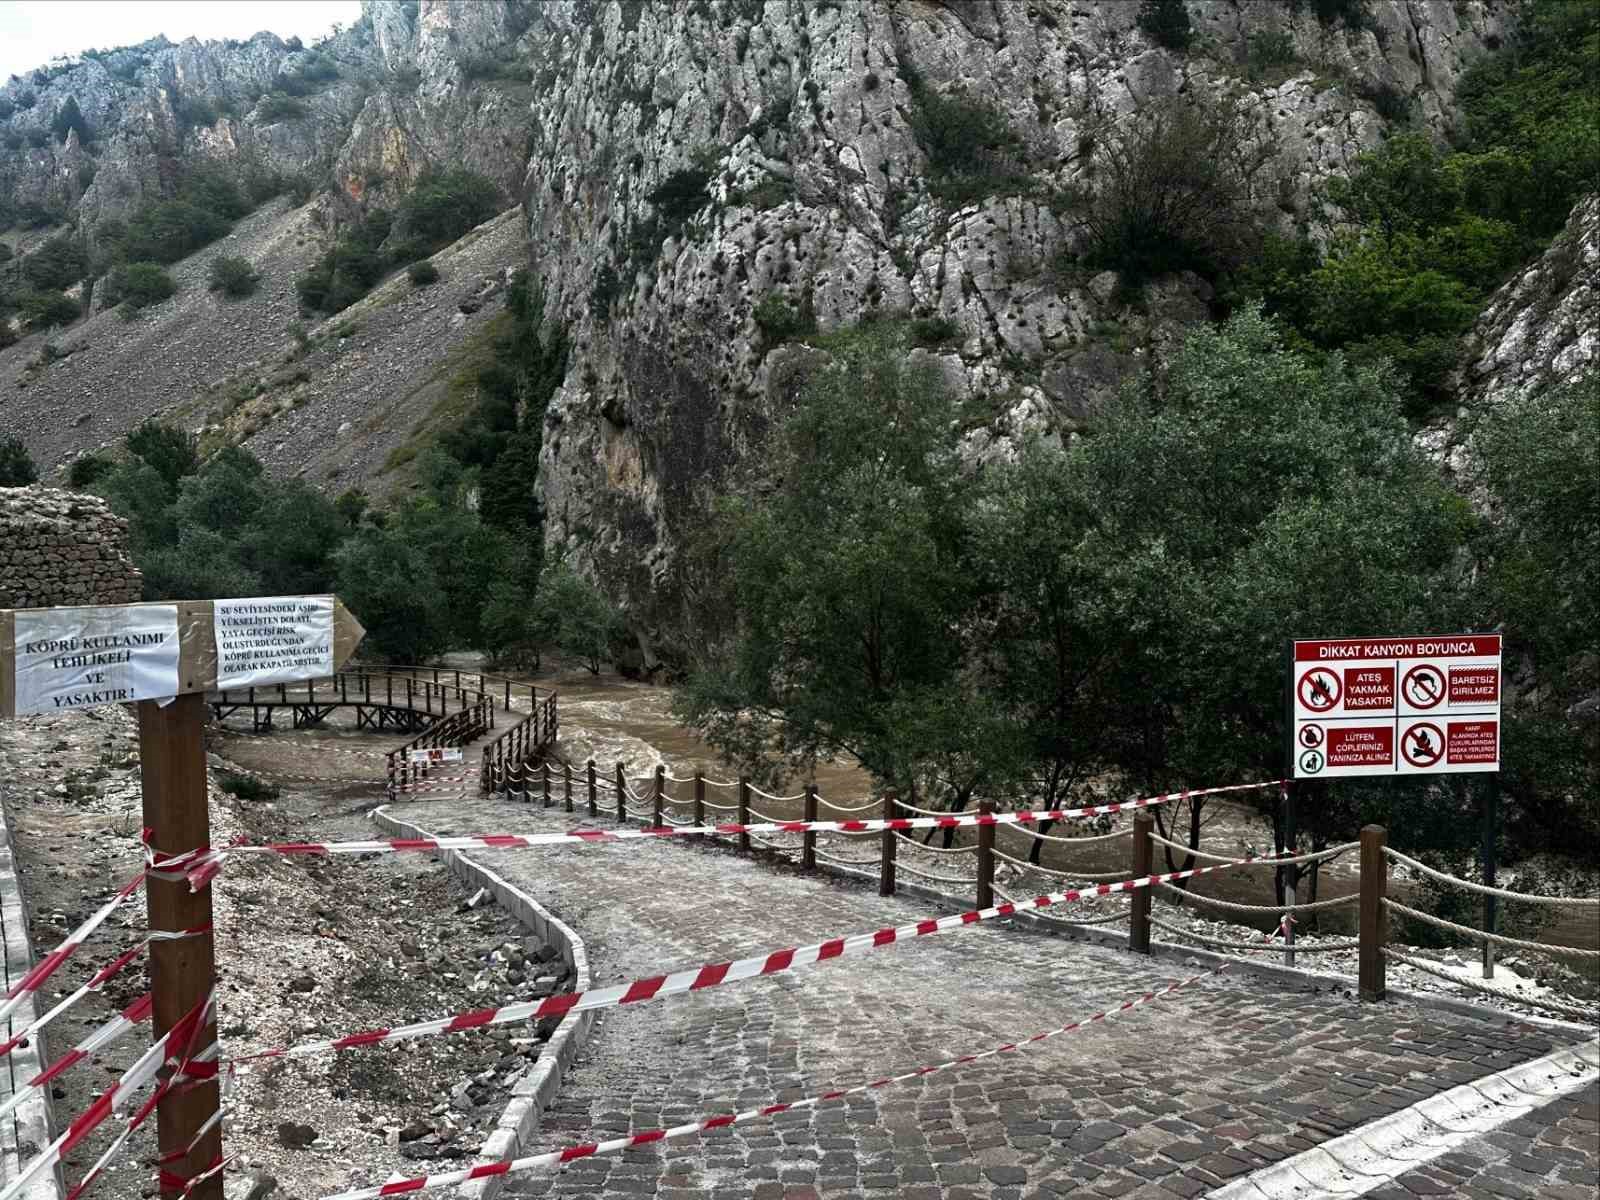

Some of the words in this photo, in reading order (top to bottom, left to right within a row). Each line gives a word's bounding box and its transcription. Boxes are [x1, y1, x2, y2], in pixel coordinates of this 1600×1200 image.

[220, 606, 233, 615] SU
[26, 637, 80, 655] KÖPRÜ
[82, 632, 165, 650] KULLANIMI
[225, 650, 254, 662] KÖPRÜ
[1319, 644, 1361, 658] DİKKAT
[1364, 644, 1413, 657] KANYON
[1416, 642, 1476, 655] BOYUNCA
[52, 649, 132, 669] TEHLİKELİ
[223, 662, 261, 674] OLARAK
[86, 672, 105, 685] VE
[1356, 673, 1382, 682] ATEŞ
[1348, 685, 1390, 694] YAKMAK
[53, 688, 127, 708] YASAKTIR
[1345, 696, 1393, 706] YASAKTIR
[1344, 732, 1375, 741] LÜTFEN
